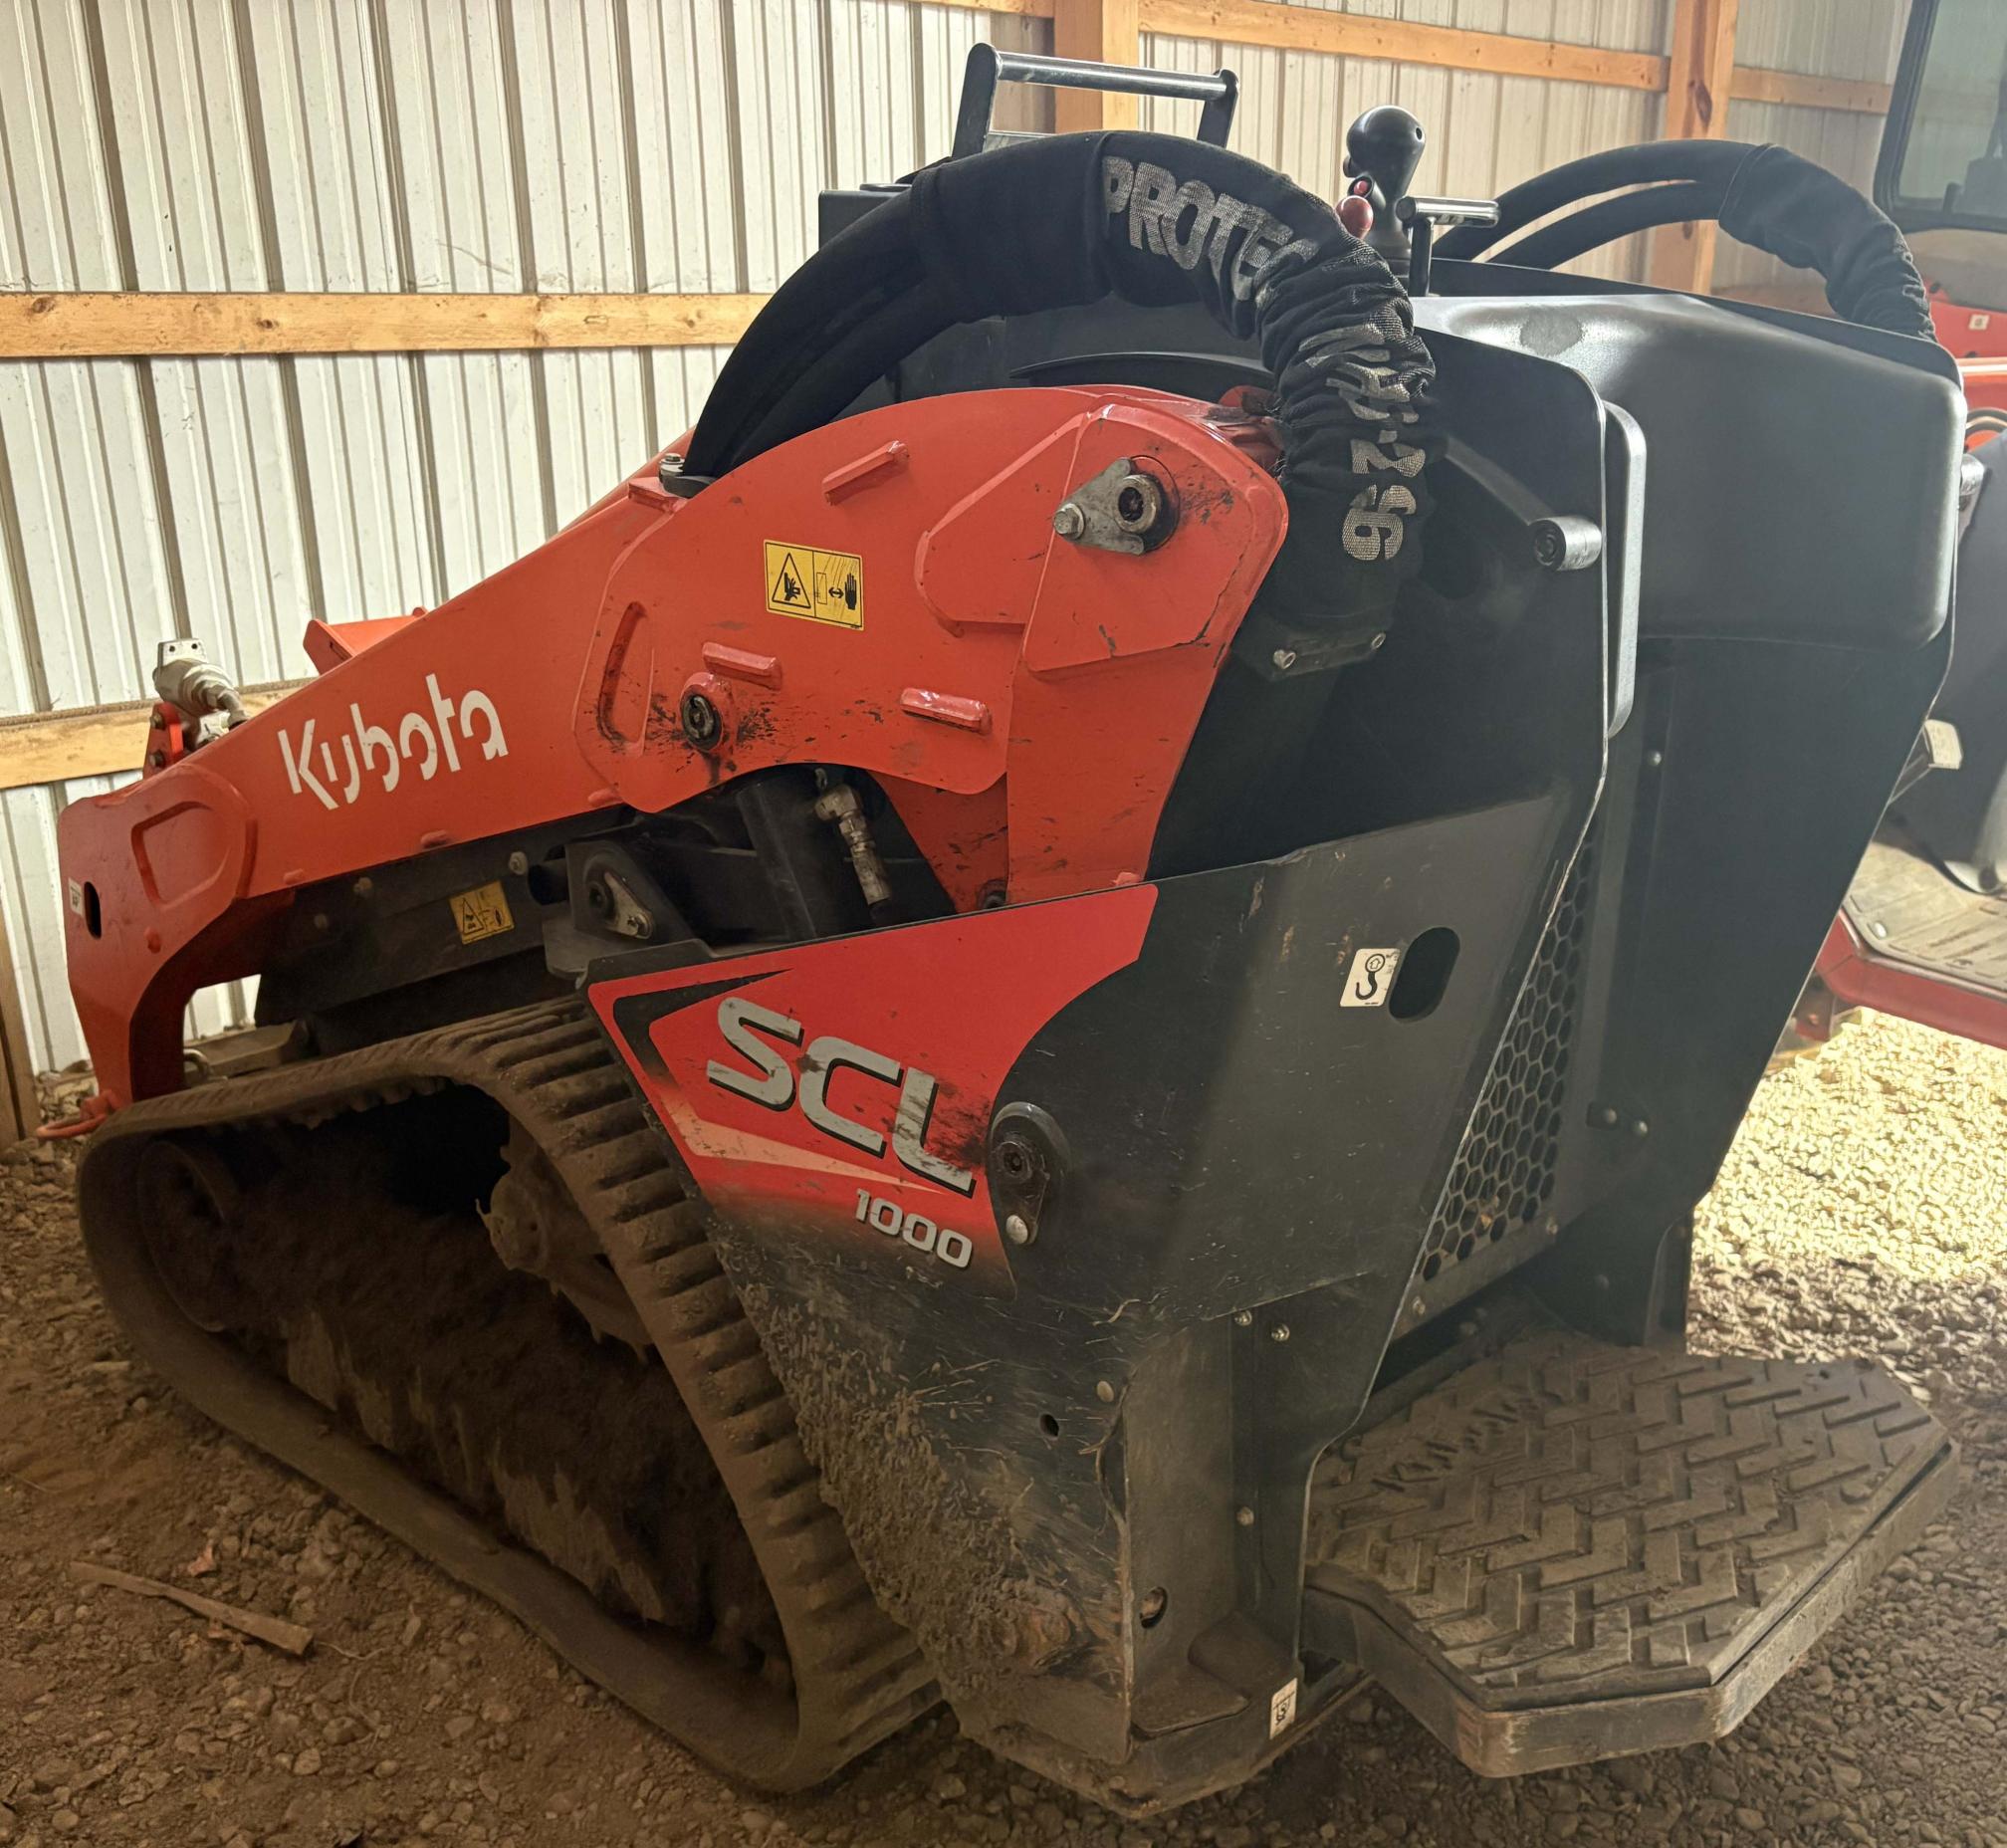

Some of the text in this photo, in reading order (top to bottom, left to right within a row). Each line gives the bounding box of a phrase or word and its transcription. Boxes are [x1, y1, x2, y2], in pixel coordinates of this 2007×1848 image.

[277, 673, 509, 810] Kubota
[707, 996, 976, 1199] SCL
[854, 1188, 974, 1268] 1000
